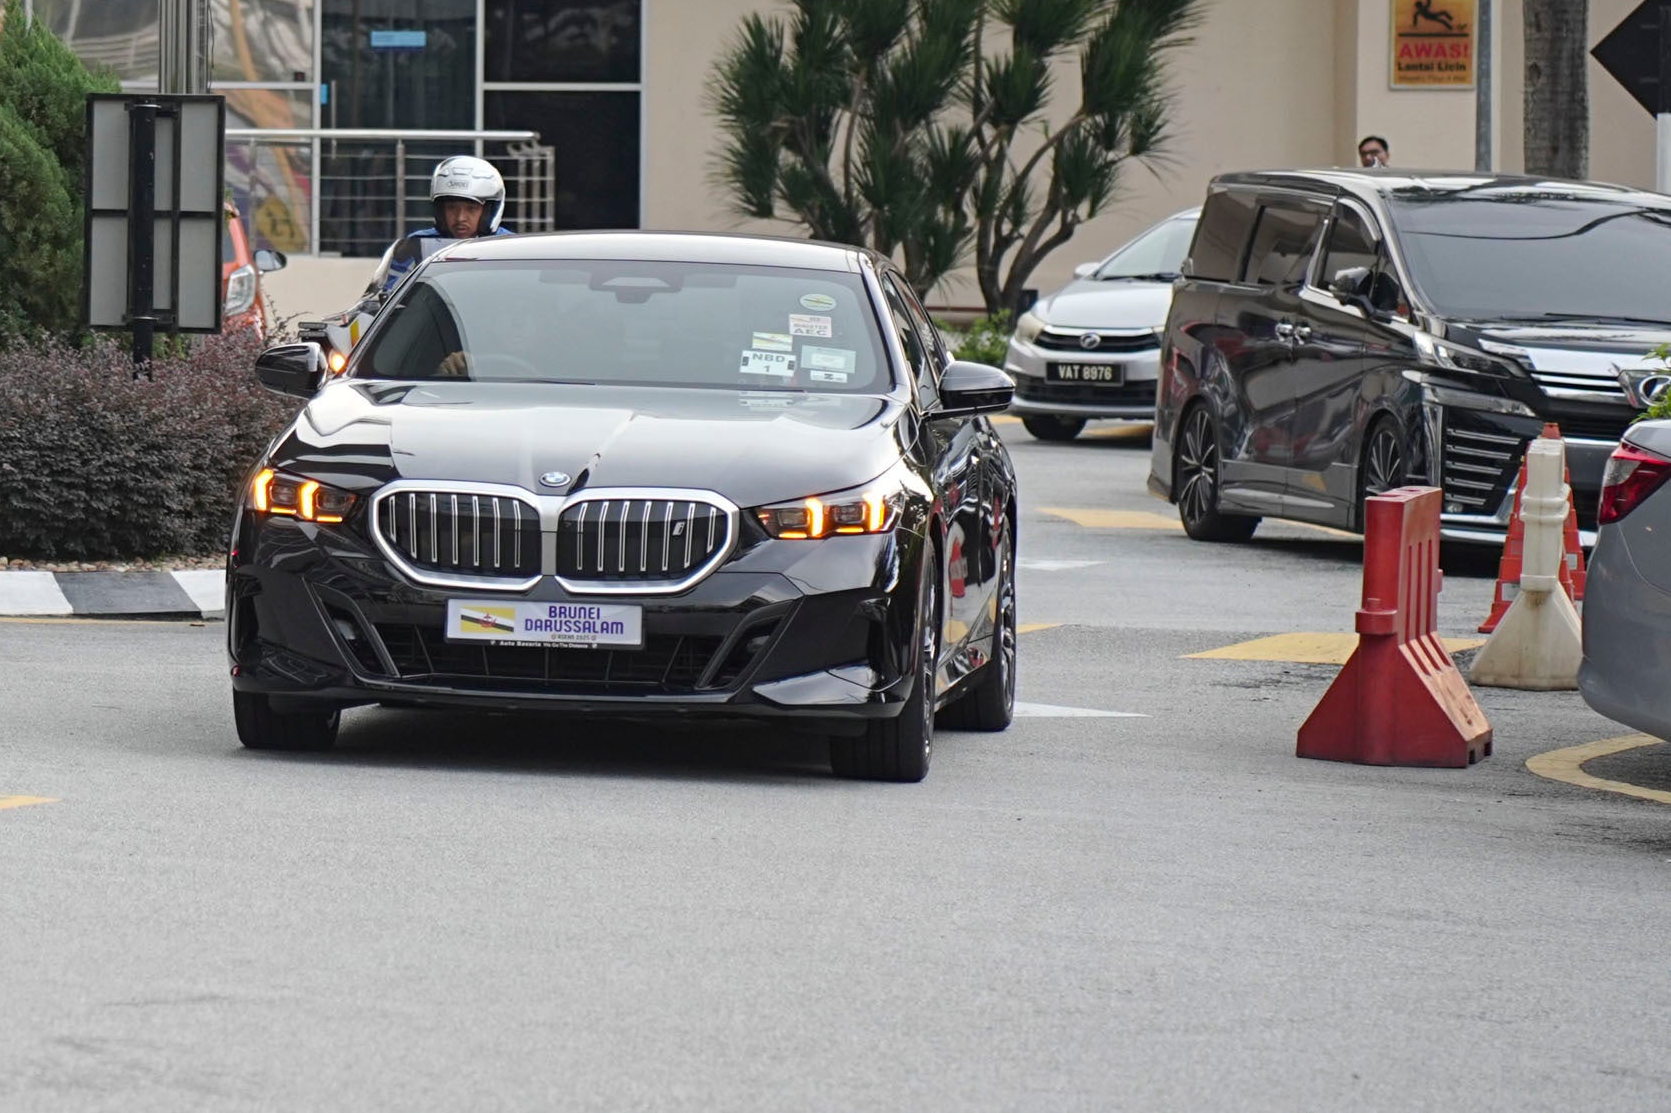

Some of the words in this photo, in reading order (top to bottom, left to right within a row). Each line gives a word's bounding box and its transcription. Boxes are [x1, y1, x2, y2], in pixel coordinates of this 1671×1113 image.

[751, 352, 786, 363] NBD
[1058, 364, 1080, 379] VAT
[548, 605, 601, 620] BRUNEI
[524, 618, 624, 635] DARUSSALAM
